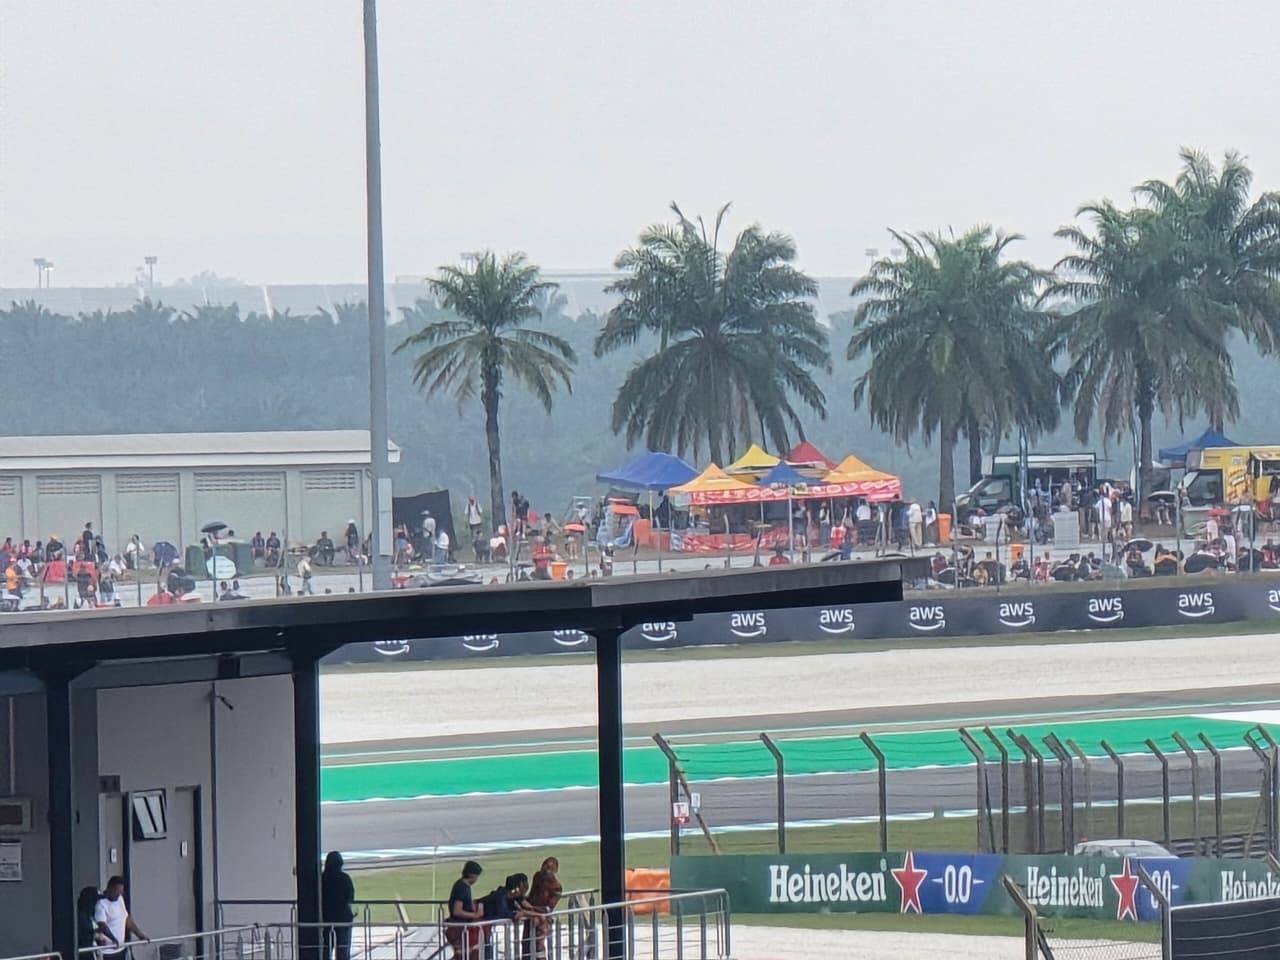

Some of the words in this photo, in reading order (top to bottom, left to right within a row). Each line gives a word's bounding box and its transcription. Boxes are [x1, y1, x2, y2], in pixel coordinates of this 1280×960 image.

[1088, 598, 1122, 612] aws
[1178, 592, 1212, 607] aws
[819, 609, 853, 623] aws
[909, 606, 944, 620] aws
[1000, 602, 1033, 616] aws
[731, 613, 764, 627] aws
[769, 863, 885, 904] Heineken
[944, 864, 972, 904] 0.0
[1027, 866, 1103, 907] Heineken
